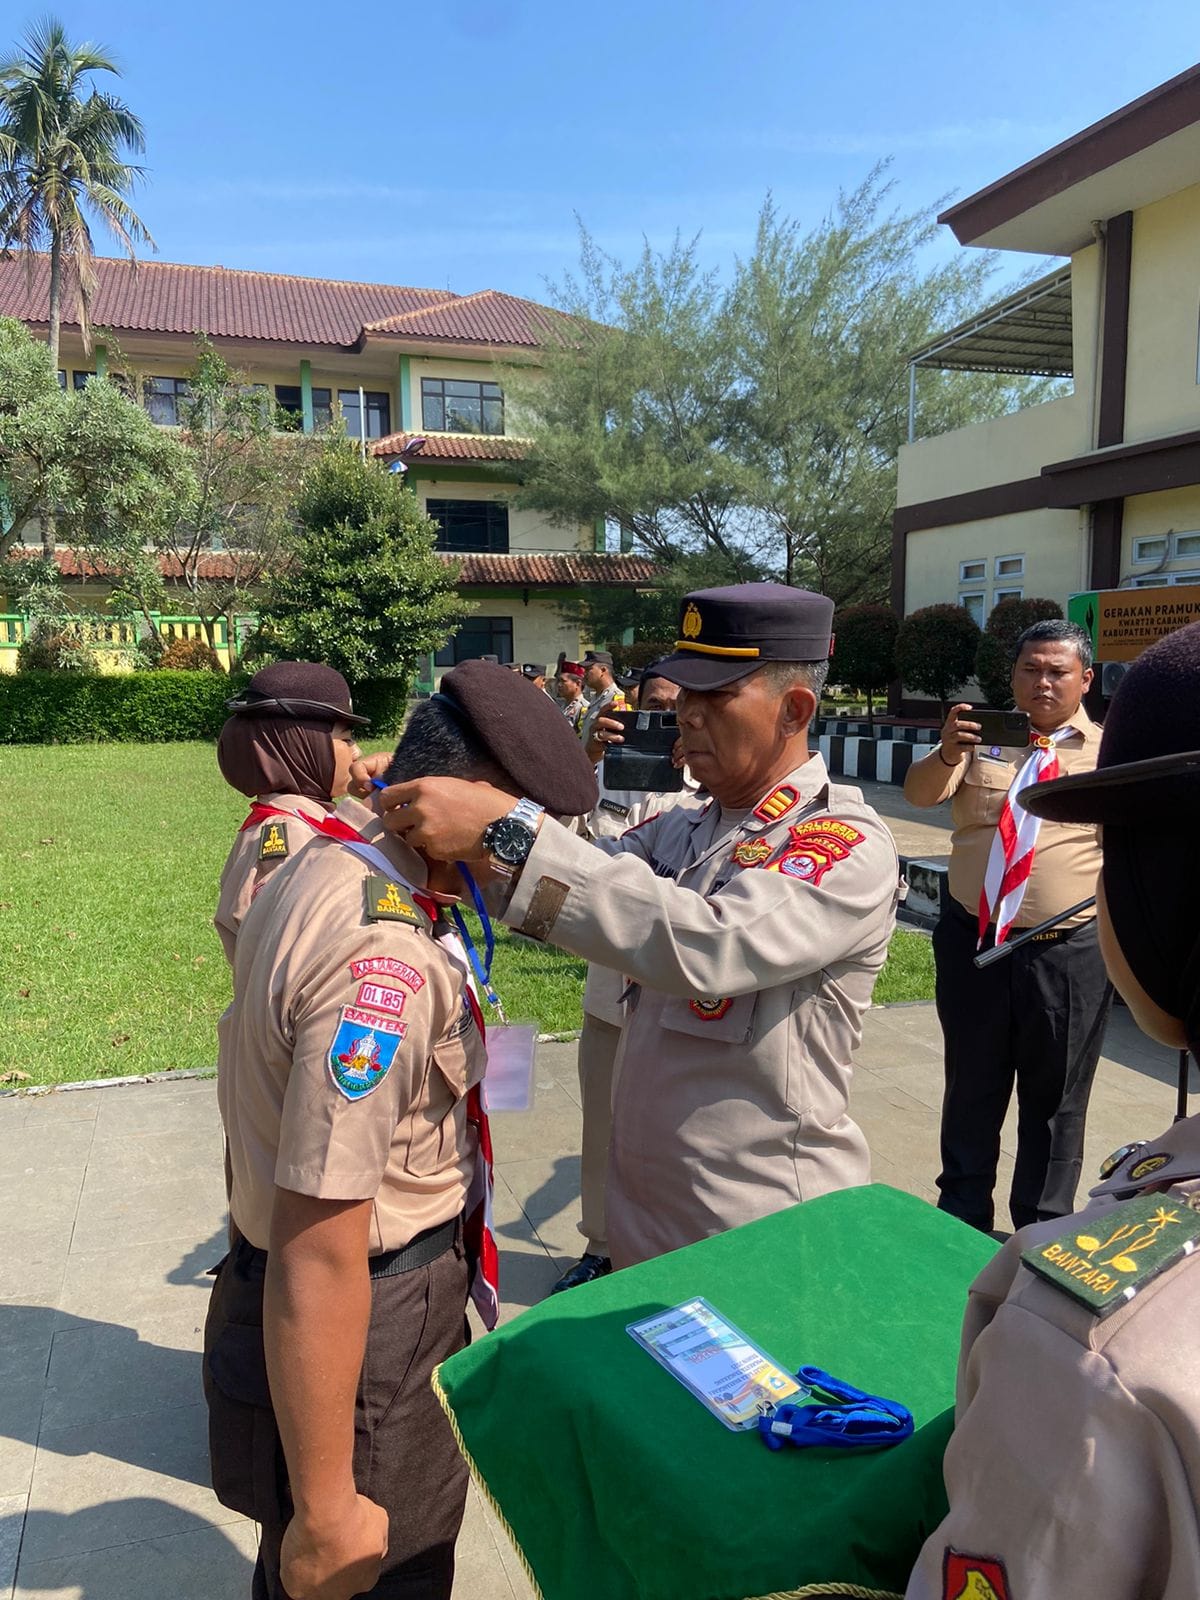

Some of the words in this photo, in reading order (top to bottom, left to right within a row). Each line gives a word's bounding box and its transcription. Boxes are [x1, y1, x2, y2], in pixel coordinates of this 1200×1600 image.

[1104, 605, 1152, 618] GERAKAN
[1118, 619, 1154, 627] KWARTIR
[1156, 616, 1190, 625] CABANG
[1103, 627, 1152, 637] KABUPATEN
[376, 905, 418, 919] BANTARA
[1032, 931, 1058, 941] OLISI
[376, 957, 421, 987] TANGERANG
[363, 987, 402, 1009] 01.185
[344, 1006, 407, 1034] BANTEN
[1041, 1244, 1120, 1295] BANTARA
